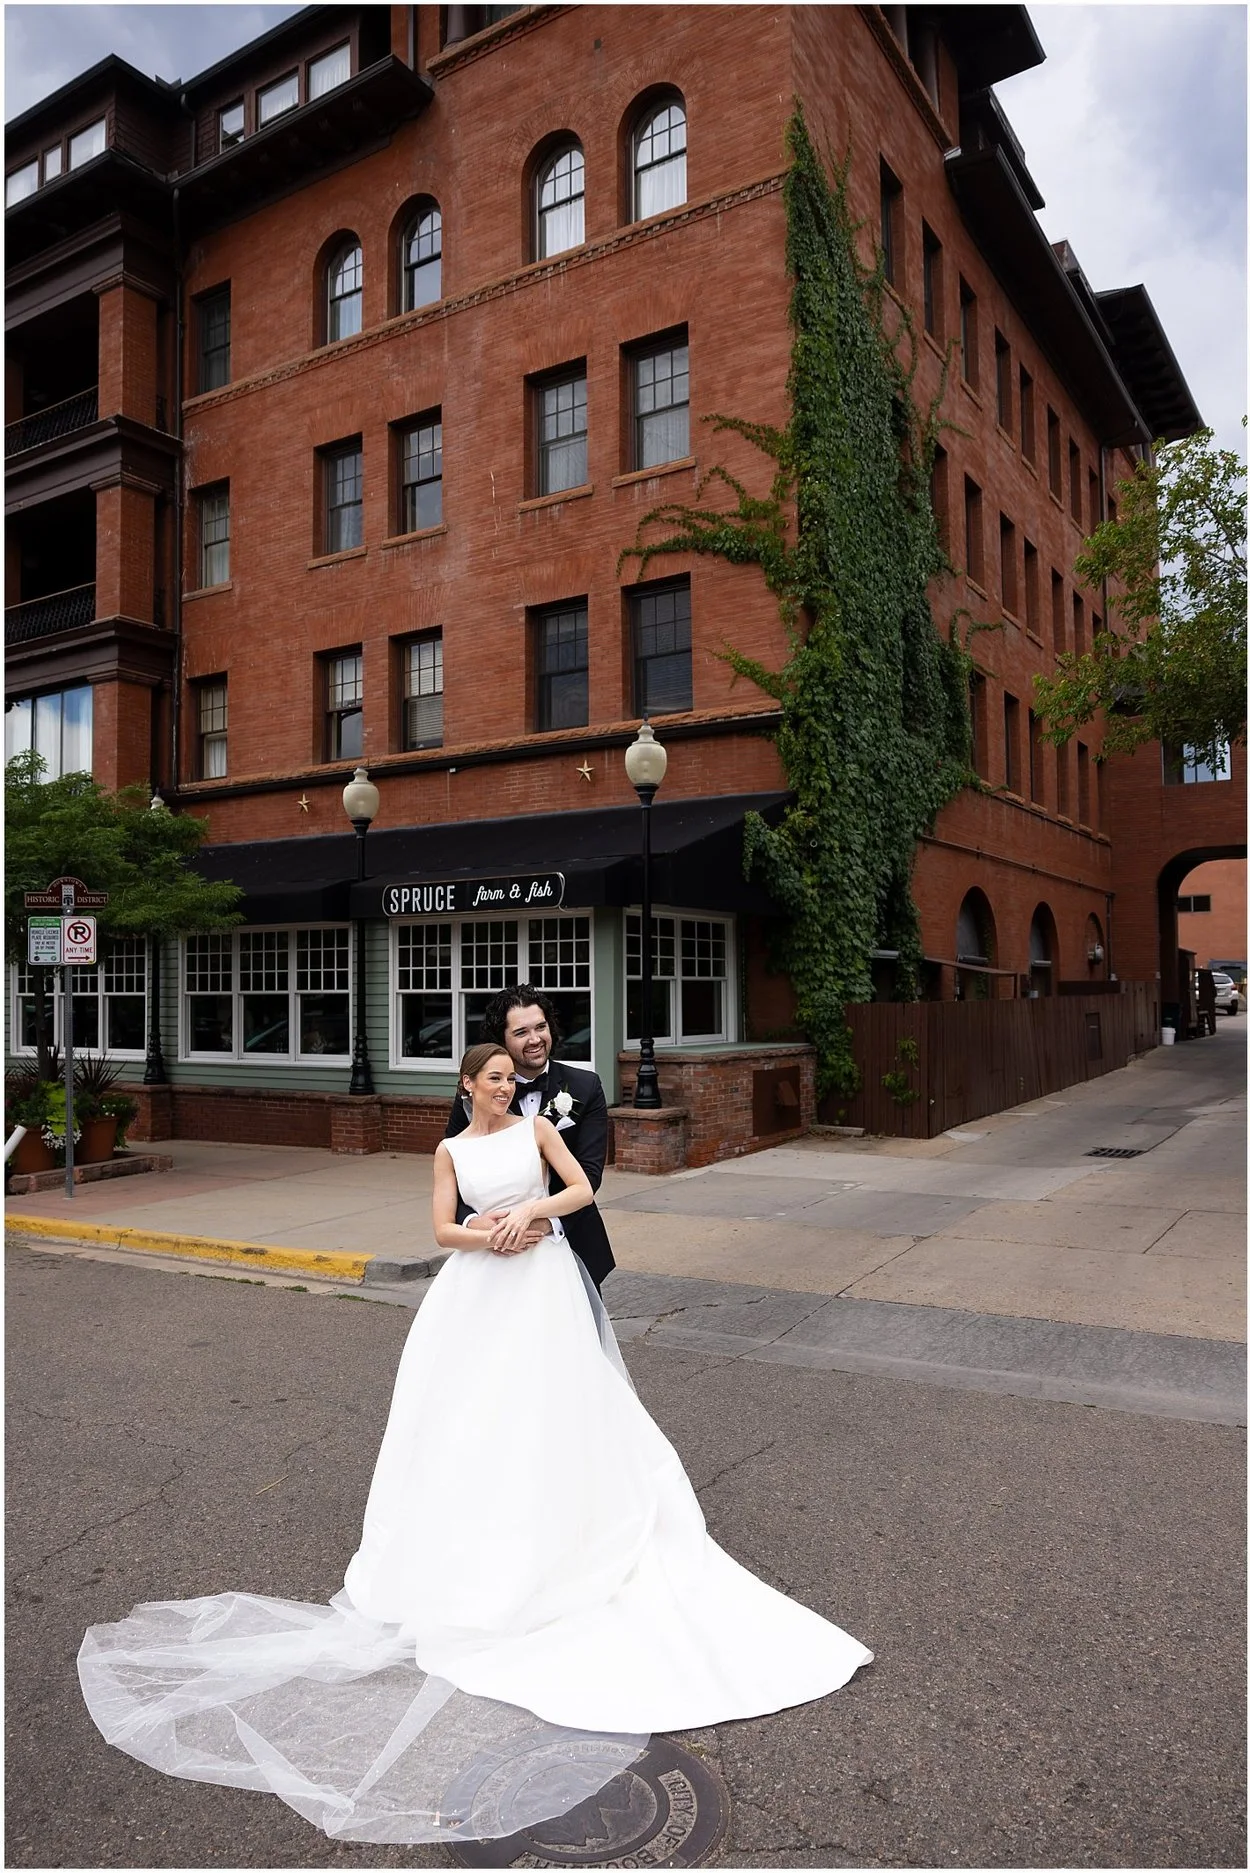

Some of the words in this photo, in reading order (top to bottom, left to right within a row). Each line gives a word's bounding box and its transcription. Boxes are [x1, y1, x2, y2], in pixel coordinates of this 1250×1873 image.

[27, 895, 60, 903] HISTORIC
[390, 885, 455, 914] SPRUCE
[472, 885, 505, 906] farm
[509, 883, 521, 899] &
[524, 880, 553, 903] fish
[66, 946, 78, 954] ANY
[79, 946, 94, 954] TIME
[667, 1780, 694, 1817] CITY
[662, 1825, 688, 1849] OF
